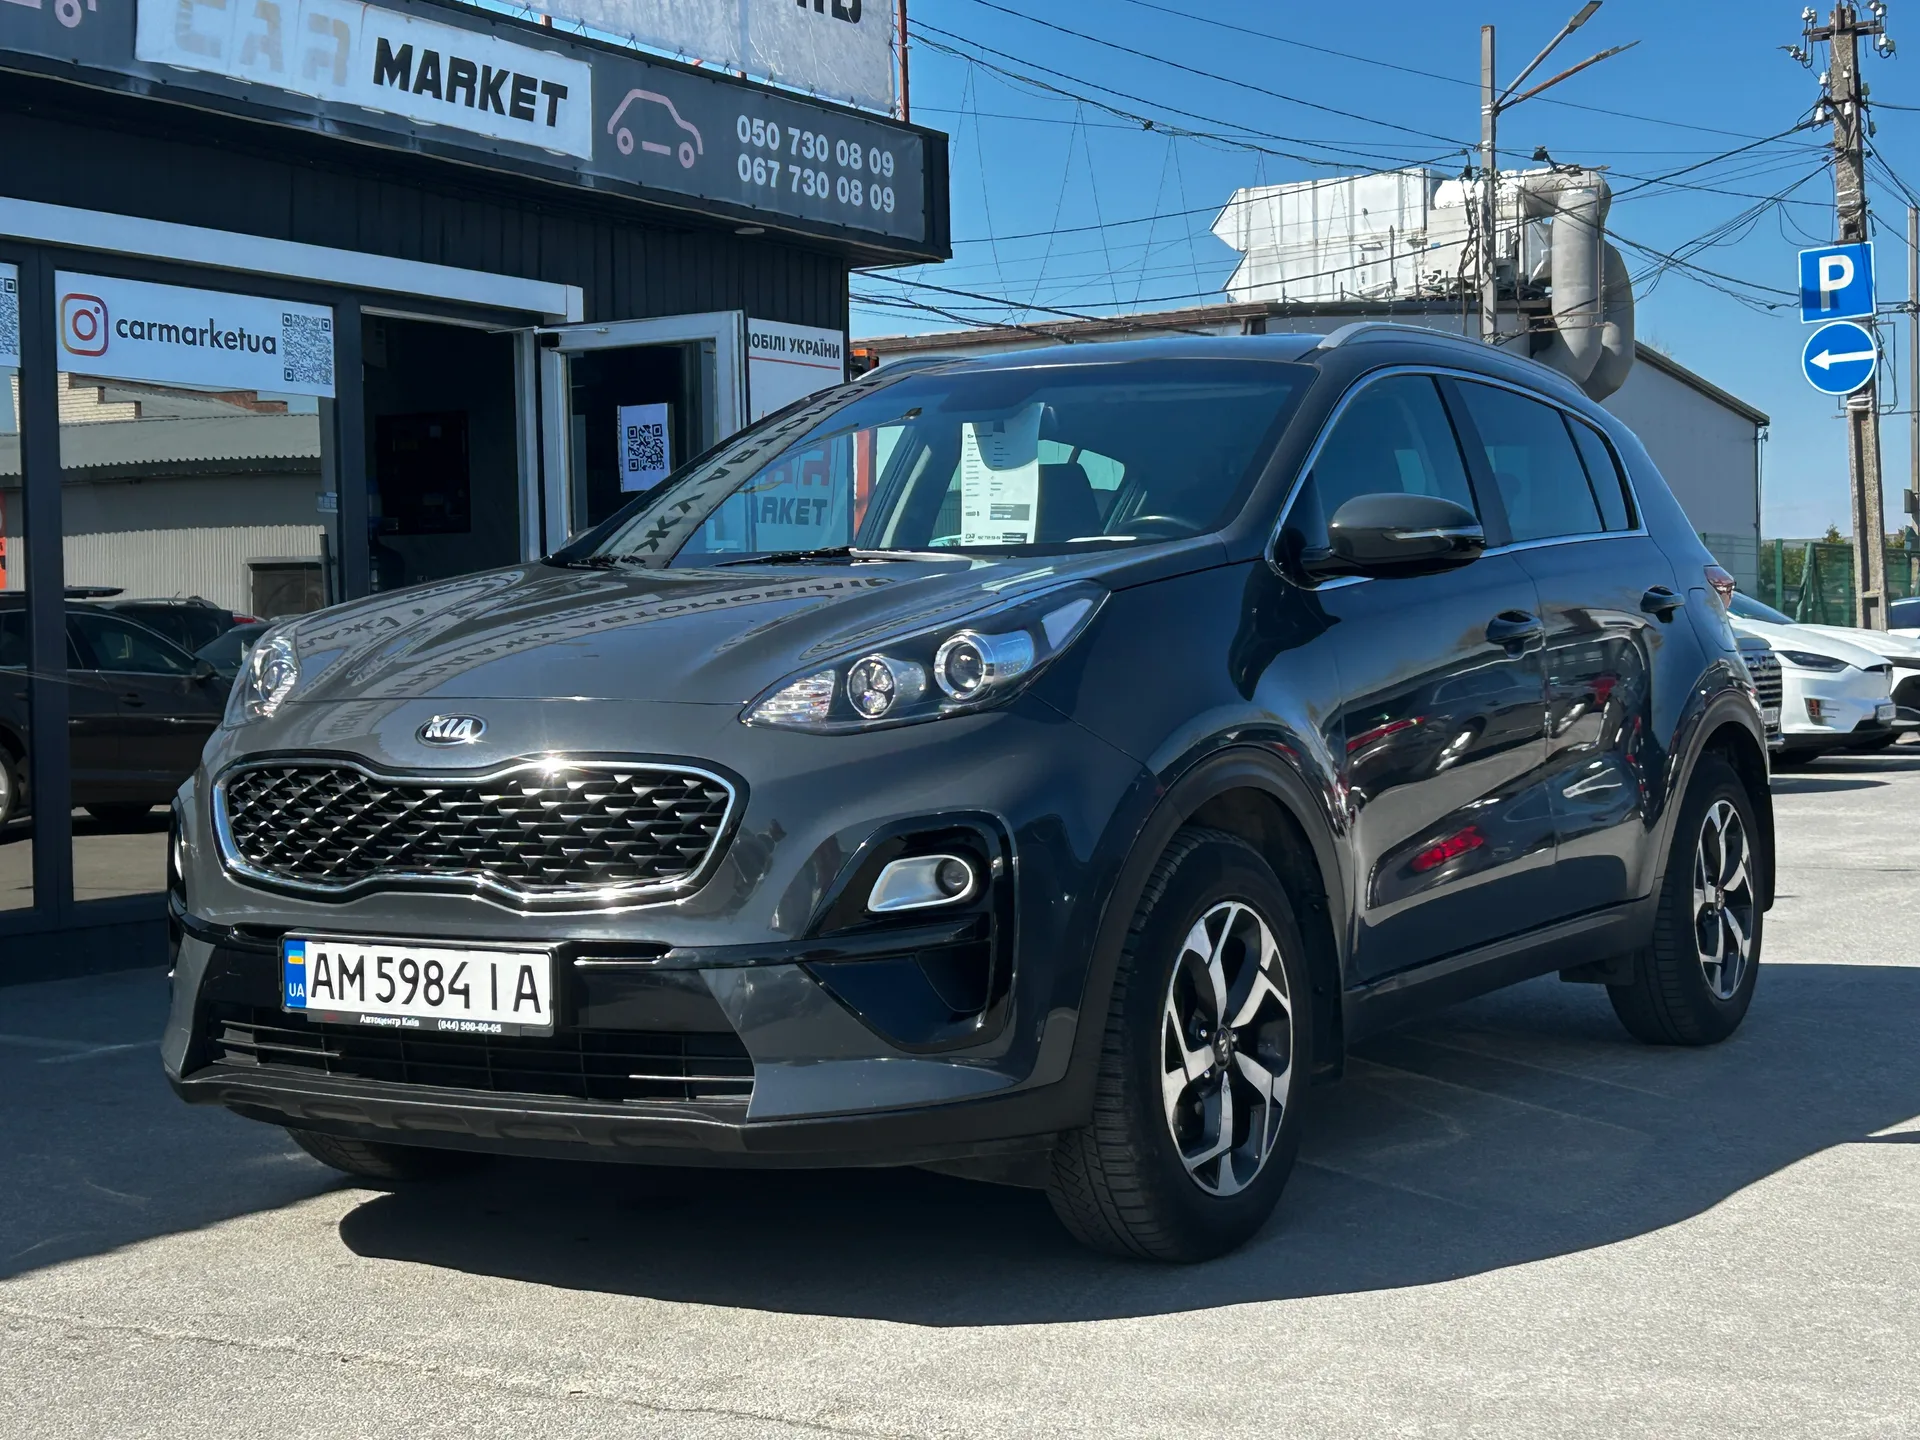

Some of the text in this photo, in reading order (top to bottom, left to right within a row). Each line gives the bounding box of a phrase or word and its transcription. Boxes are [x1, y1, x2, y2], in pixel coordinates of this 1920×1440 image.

[175, 0, 569, 128] CAR MARKET
[736, 115, 894, 178] 050 730 08 09
[737, 153, 895, 213] 067 730 08 09
[1818, 254, 1855, 312] P
[115, 318, 277, 355] carmarketua
[788, 337, 841, 360] УКРАЇНИ
[424, 718, 474, 739] KIA
[288, 982, 305, 998] UA
[310, 953, 541, 1013] AM 5984 IA
